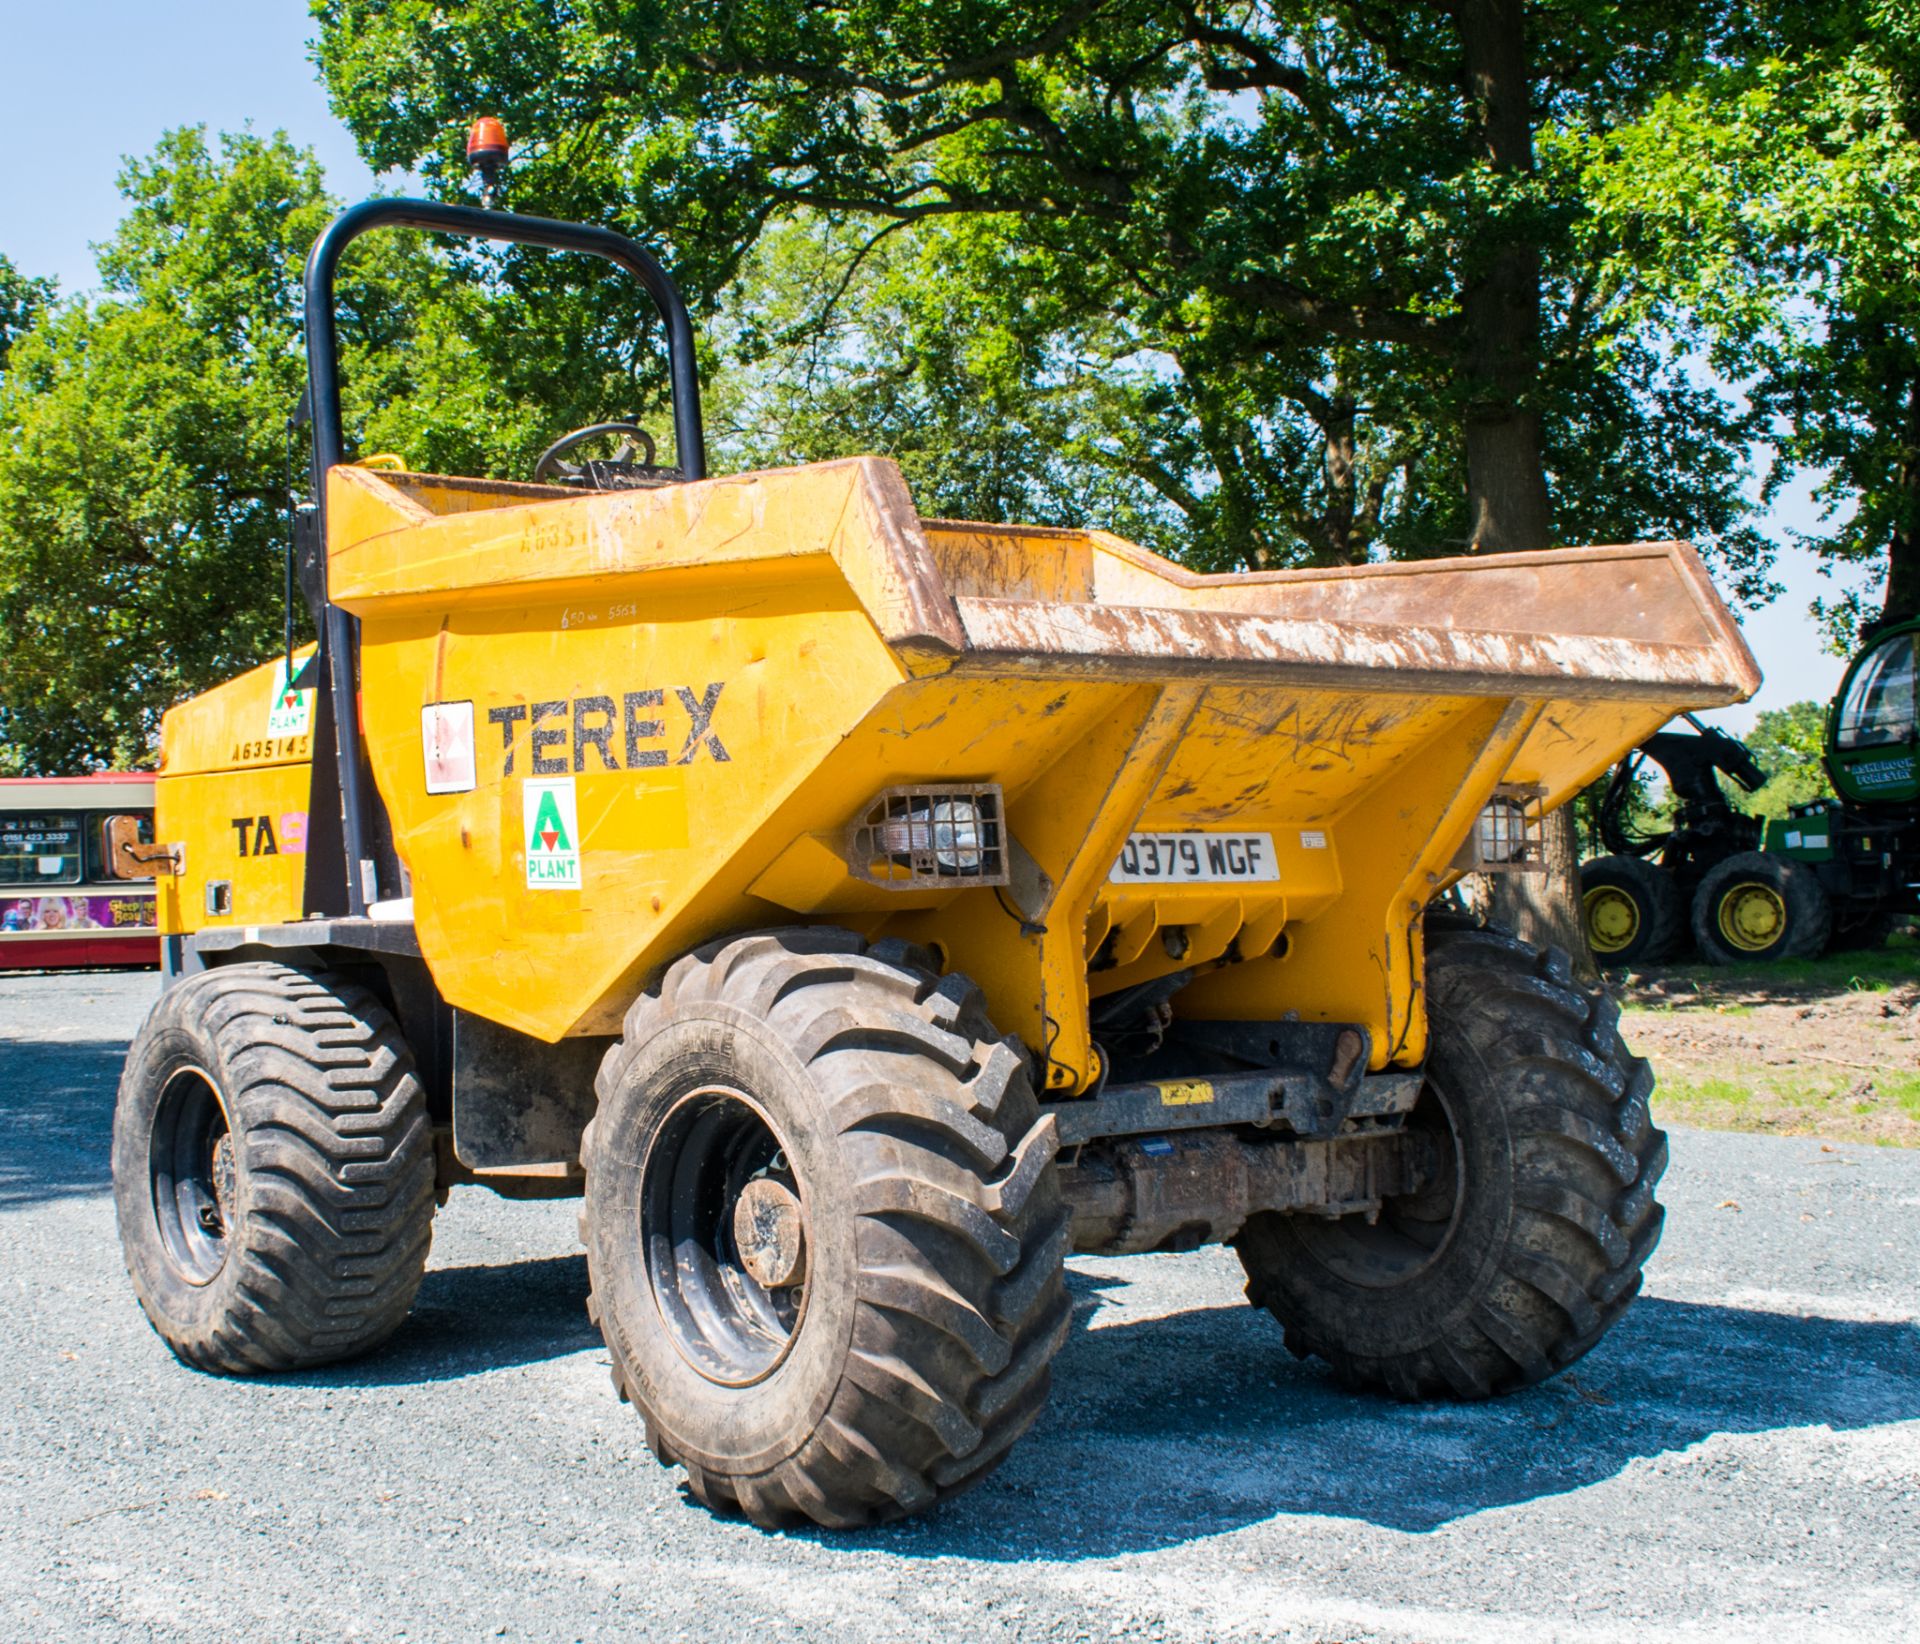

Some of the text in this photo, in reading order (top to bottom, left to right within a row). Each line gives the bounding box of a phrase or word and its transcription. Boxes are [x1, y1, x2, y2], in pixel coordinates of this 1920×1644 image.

[270, 713, 305, 730] PLANT
[488, 681, 732, 777] TEREX
[232, 735, 309, 761] A635145
[1856, 768, 1912, 786] FORESTRY
[530, 790, 572, 850] A
[1121, 839, 1200, 875] Q379
[1204, 838, 1261, 874] WGF
[528, 859, 576, 878] PLANT
[109, 899, 155, 913] Sleepng
